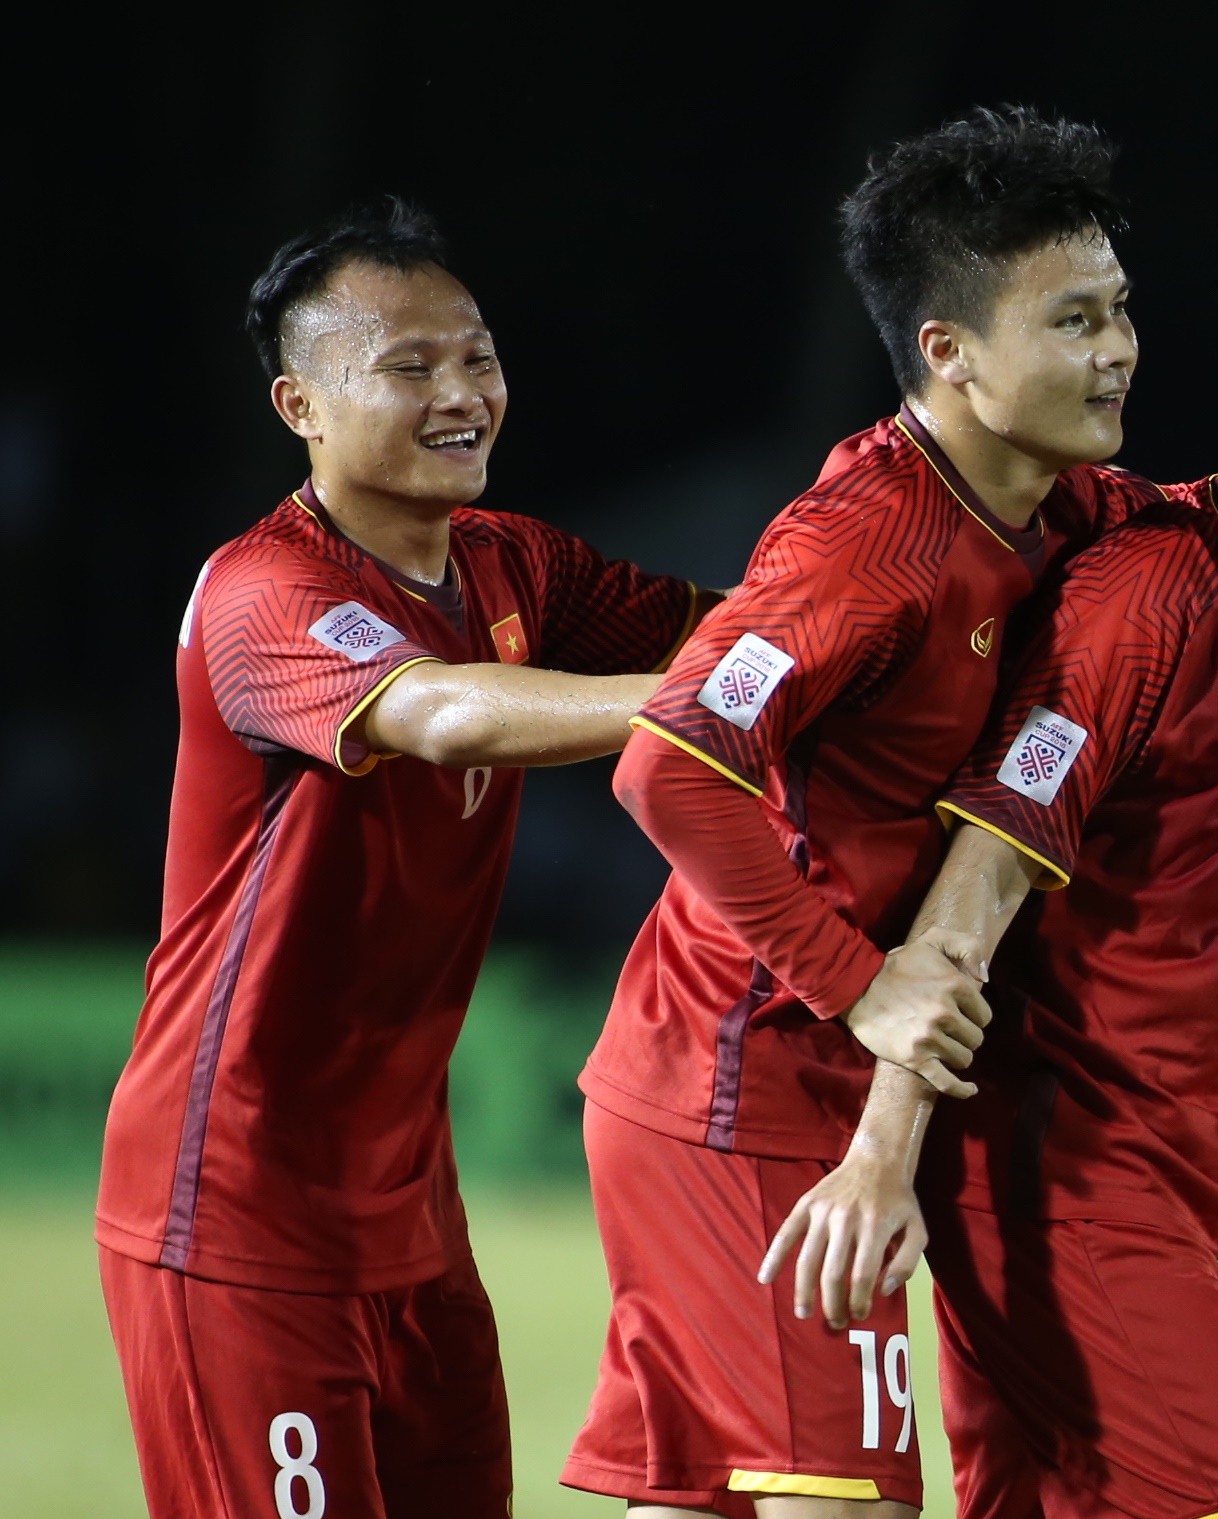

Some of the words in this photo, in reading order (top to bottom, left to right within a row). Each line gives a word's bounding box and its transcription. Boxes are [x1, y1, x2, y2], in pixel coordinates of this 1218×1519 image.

[324, 610, 358, 635] SUZUKI
[743, 647, 778, 670] SUZUKI
[1035, 721, 1073, 746] SUZUKI
[848, 1329, 913, 1453] 19
[268, 1411, 326, 1519] 8
